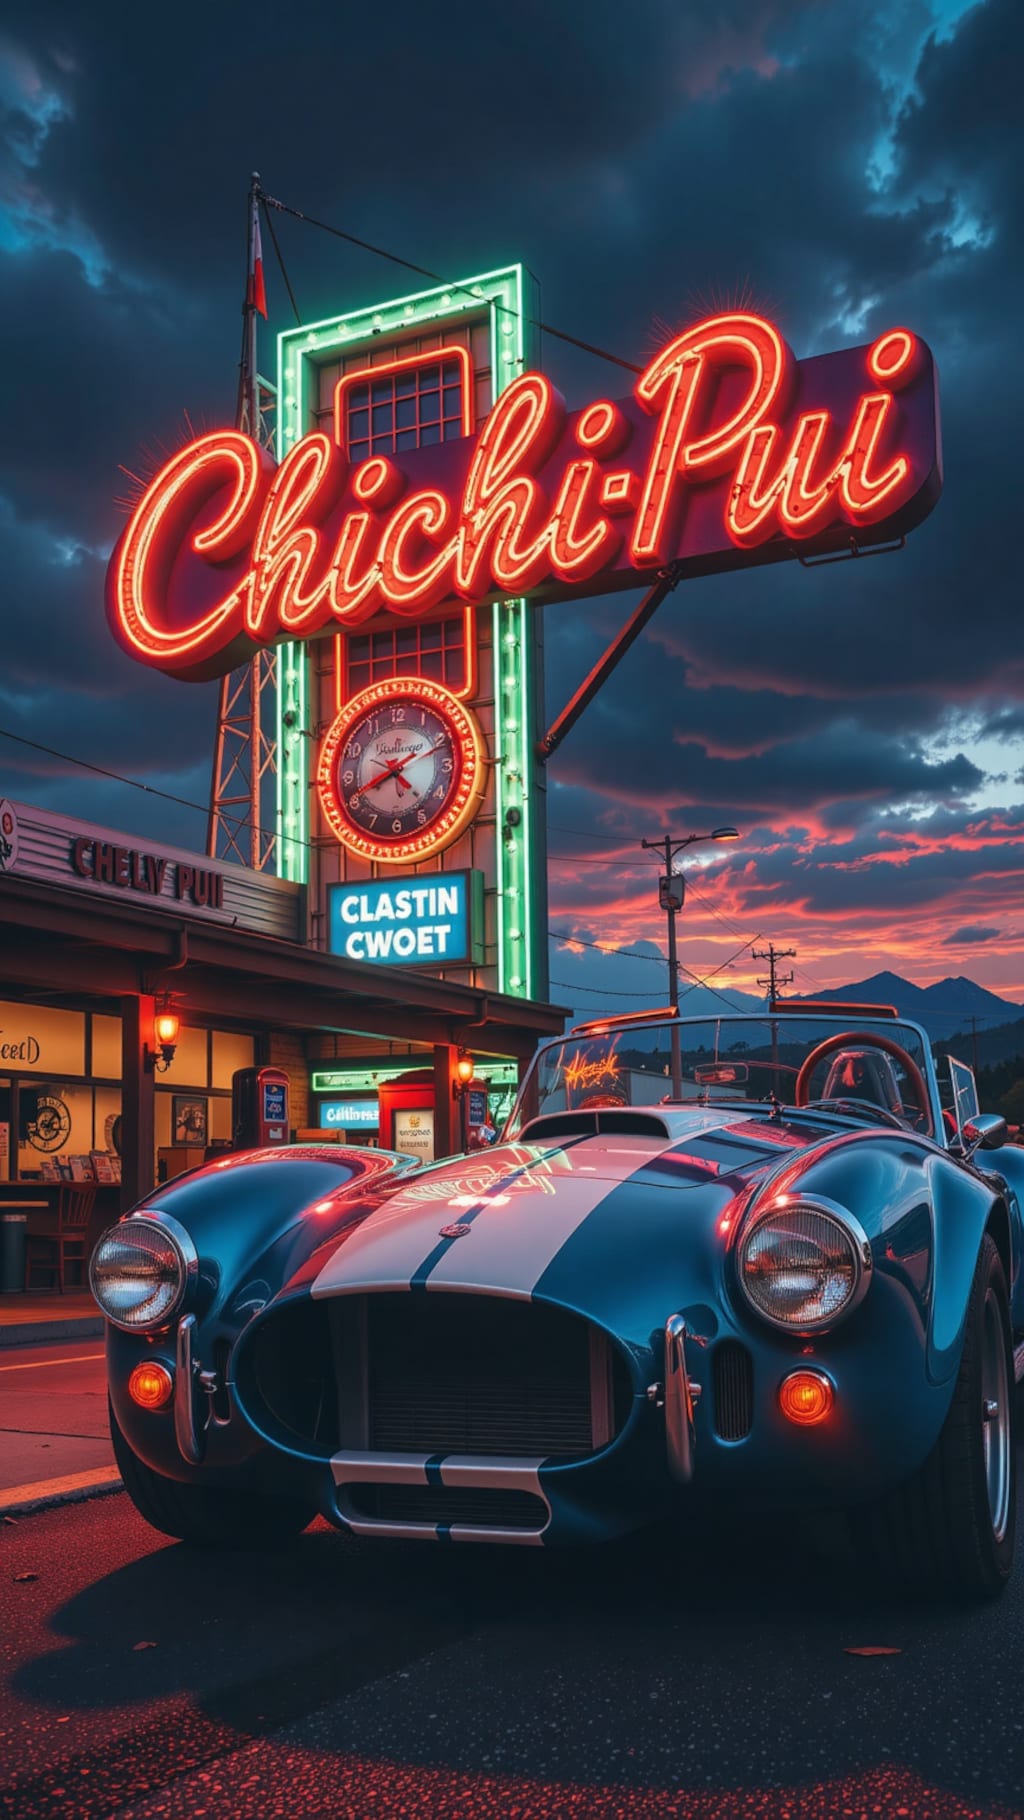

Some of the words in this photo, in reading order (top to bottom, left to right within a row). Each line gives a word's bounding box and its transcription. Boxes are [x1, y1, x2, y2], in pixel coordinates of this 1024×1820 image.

[391, 708, 405, 722] 12
[435, 732, 446, 747] 2
[441, 758, 453, 771] 3
[343, 770, 354, 785] 9
[433, 785, 445, 800] 4
[368, 814, 379, 829] 7
[341, 886, 459, 923] CLASTIN
[346, 924, 451, 960] CWOET
